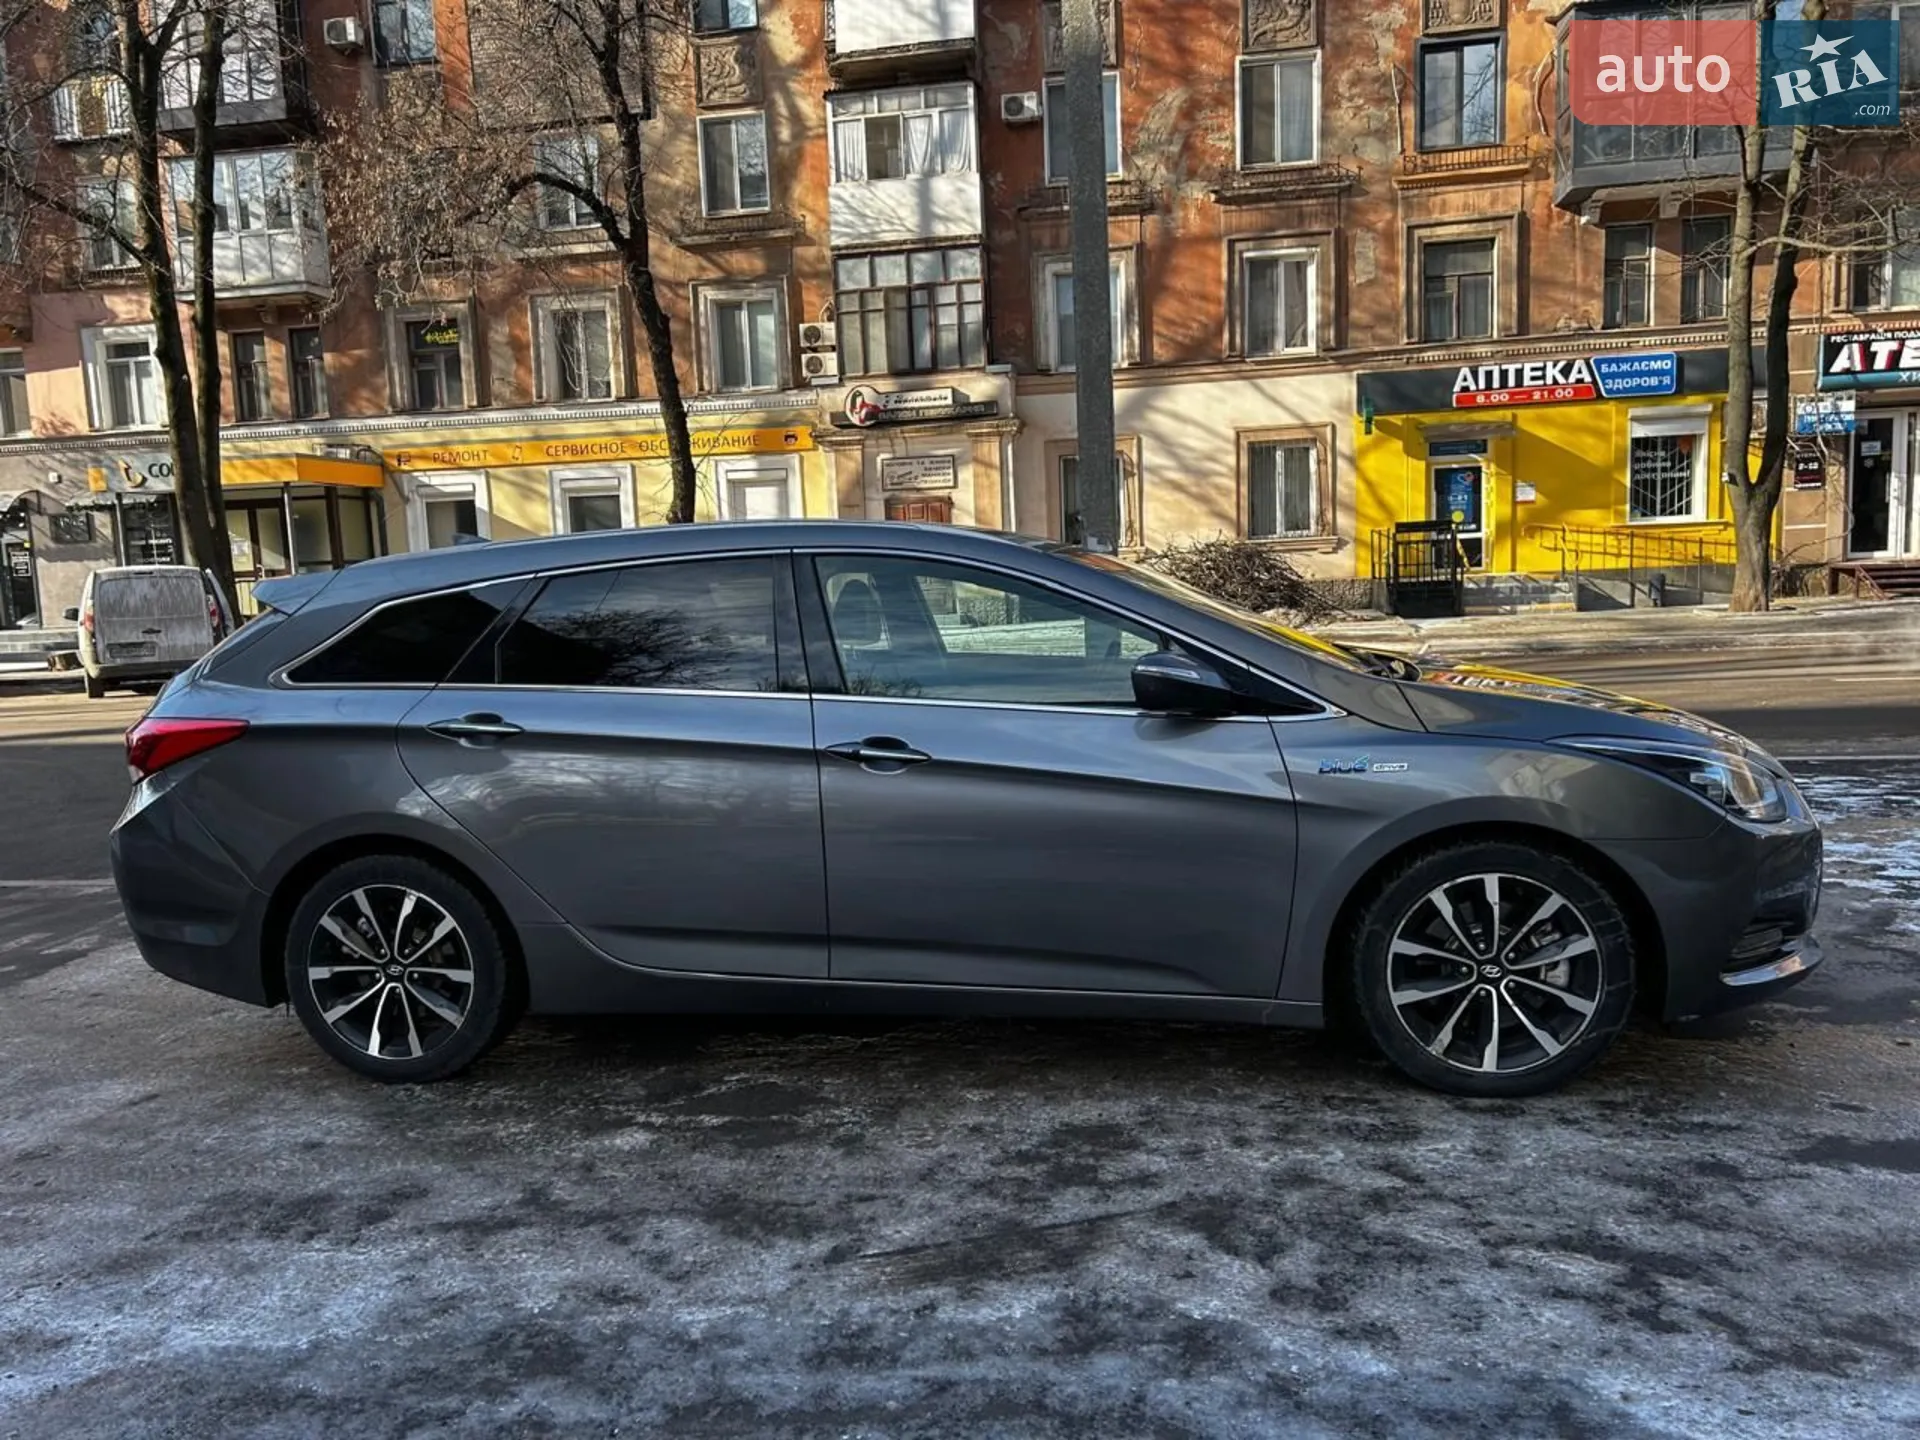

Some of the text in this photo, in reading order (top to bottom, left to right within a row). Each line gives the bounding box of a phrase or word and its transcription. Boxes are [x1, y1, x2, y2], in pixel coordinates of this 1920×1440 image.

[1601, 358, 1673, 374] БАЖАЄМО
[1453, 359, 1593, 393] АПТЕКА
[1605, 375, 1672, 390] ЗДОРОВ'Я
[1476, 391, 1510, 403] 8.00
[1532, 388, 1574, 400] 21.00
[433, 434, 760, 464] РЕМОНТ СЕРВИСНОЕ ОБСЖИВАНИЕ
[148, 462, 174, 478] СО
